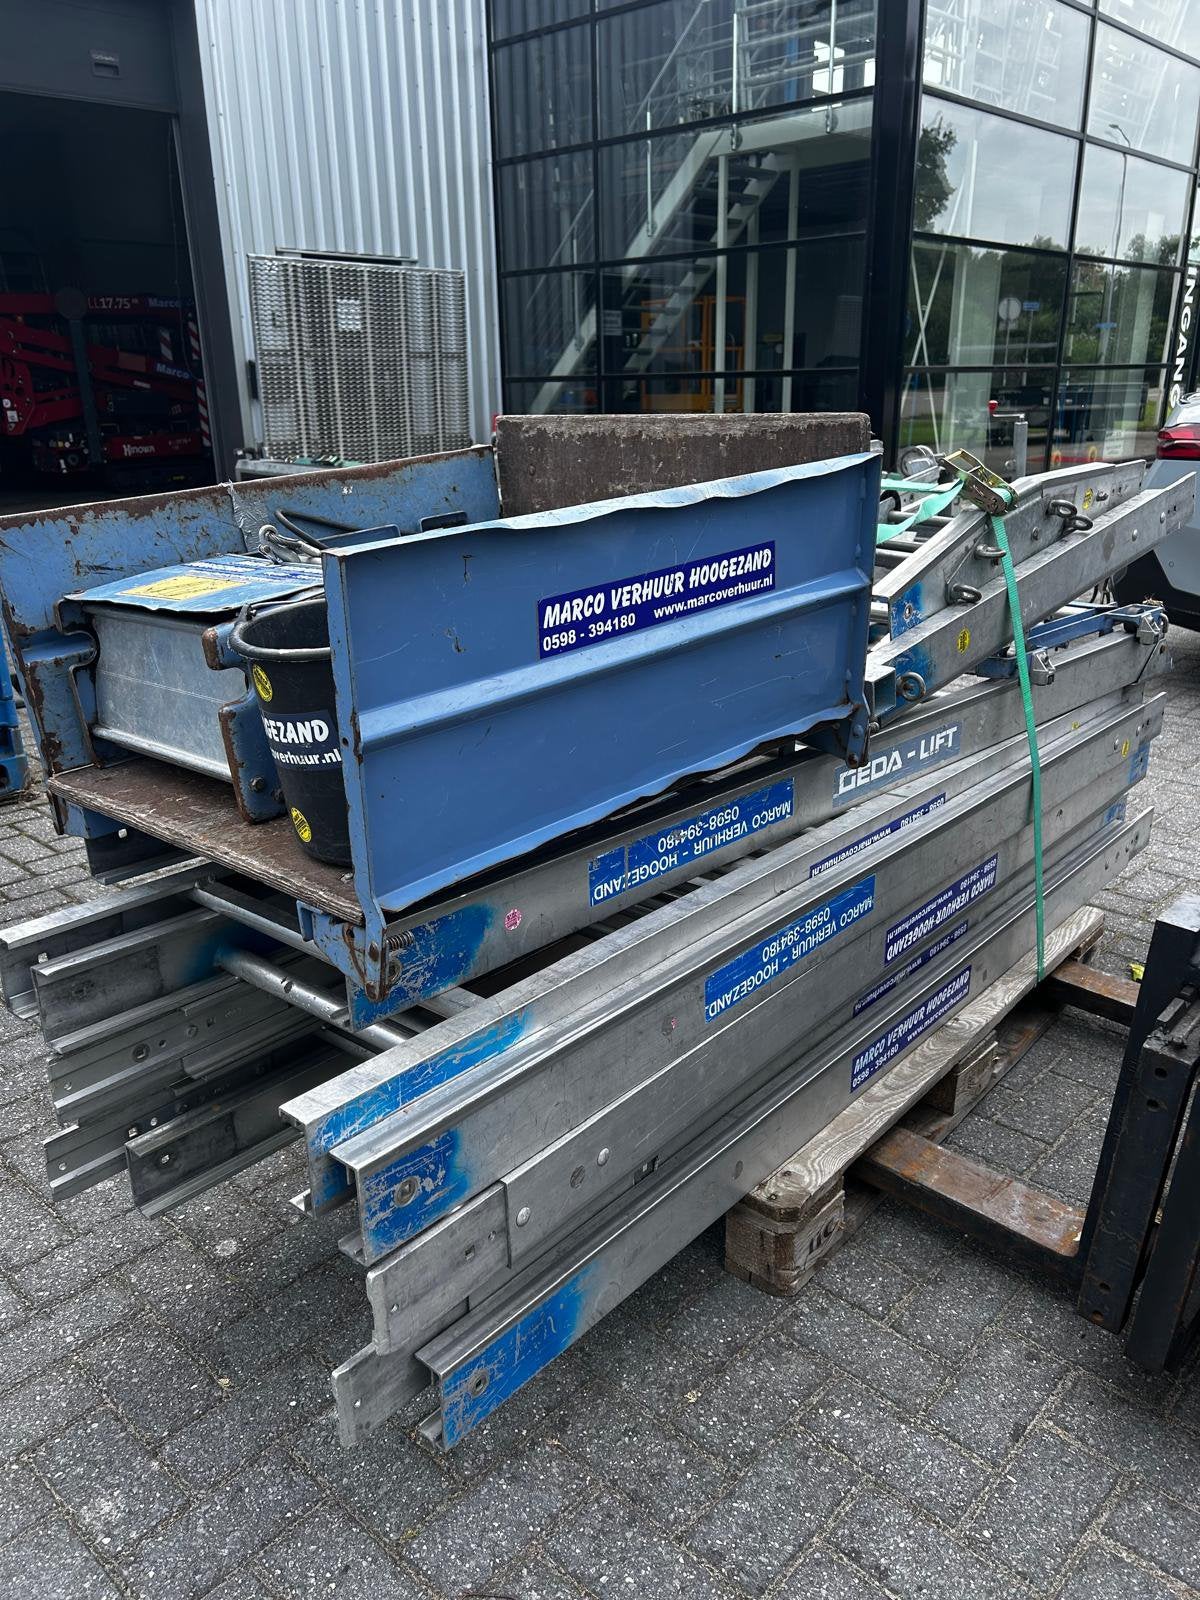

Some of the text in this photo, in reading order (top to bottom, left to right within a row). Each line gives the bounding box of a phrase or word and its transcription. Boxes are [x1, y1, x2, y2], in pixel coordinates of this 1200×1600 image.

[1169, 266, 1198, 408] INGANG
[156, 362, 190, 379] Marco
[543, 548, 772, 629] MARCO VERHUUR HOOGEZAND
[653, 574, 773, 619] www.marcoverhuur.nl
[542, 627, 577, 651] 0598
[588, 613, 636, 638] 394180
[262, 717, 329, 743] GEZAND
[838, 750, 903, 795] GEDA
[920, 726, 957, 760] LIFT
[752, 801, 791, 828] MARCO
[694, 820, 748, 855] VERHUUR
[812, 828, 891, 878] www.marcoverhuur.nl
[593, 854, 678, 900] HOOGEZAND
[960, 870, 980, 890] 394180
[983, 858, 997, 873] 0598
[840, 895, 873, 926] MARCO
[887, 870, 996, 961] MARCO VERHUUR HOOGEZAND
[887, 890, 953, 943] www.marcoverhuur.nl
[762, 907, 830, 962] 0598-394180
[792, 920, 836, 960] VERHUUR
[854, 970, 970, 1075] MARCO VERHUUR HOOGEZAND
[907, 985, 969, 1041] www.marcoverhuur.nl
[852, 1069, 869, 1088] 0598
[874, 1044, 899, 1069] 394180
